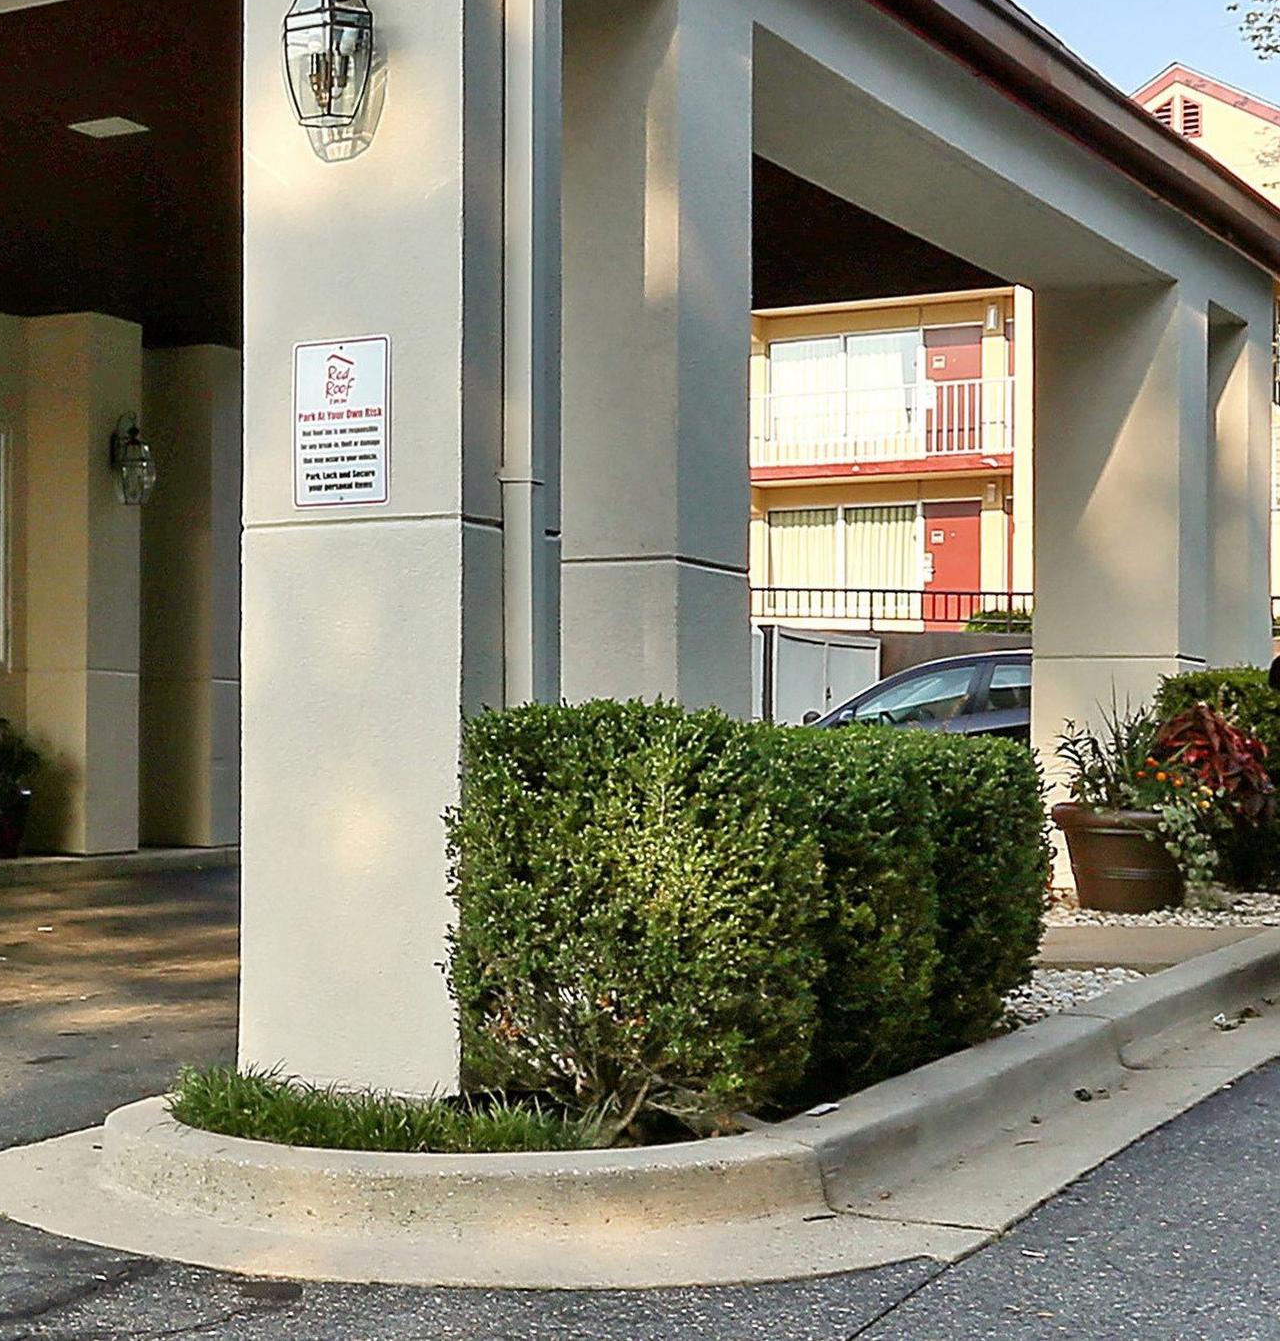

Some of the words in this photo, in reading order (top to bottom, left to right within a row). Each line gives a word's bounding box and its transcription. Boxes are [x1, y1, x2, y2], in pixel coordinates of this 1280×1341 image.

[327, 365, 351, 381] Red
[325, 377, 355, 399] Roof
[298, 412, 316, 423] Park
[327, 411, 344, 420] Your
[346, 409, 363, 419] Own
[364, 407, 382, 418] Risk
